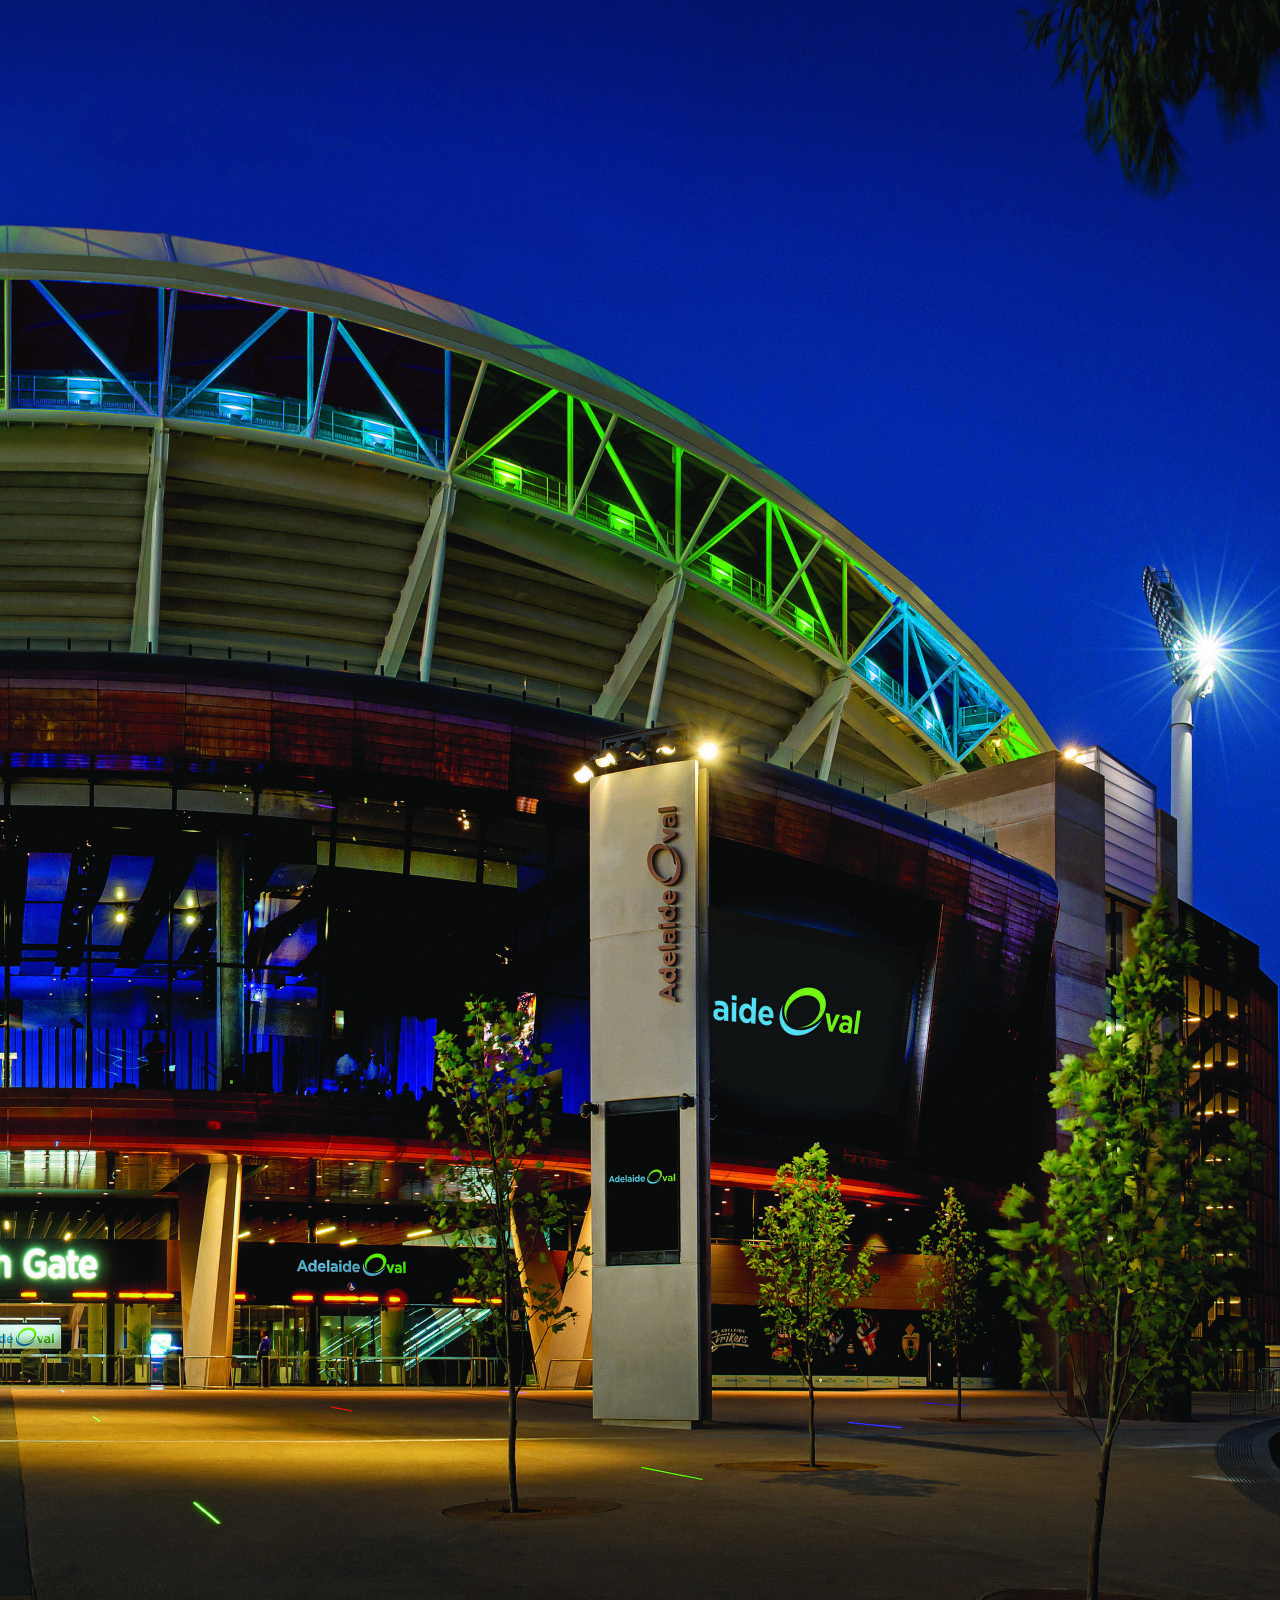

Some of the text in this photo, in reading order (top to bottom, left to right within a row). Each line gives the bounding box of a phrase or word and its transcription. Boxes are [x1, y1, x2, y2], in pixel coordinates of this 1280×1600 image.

[647, 806, 682, 1003] Adelaide Oval
[779, 987, 862, 1036] Oval
[608, 1168, 676, 1185] Adelaide Oval
[22, 1247, 98, 1280] Gate
[296, 1252, 407, 1277] Adelaide Oval
[15, 1326, 55, 1347] Oval
